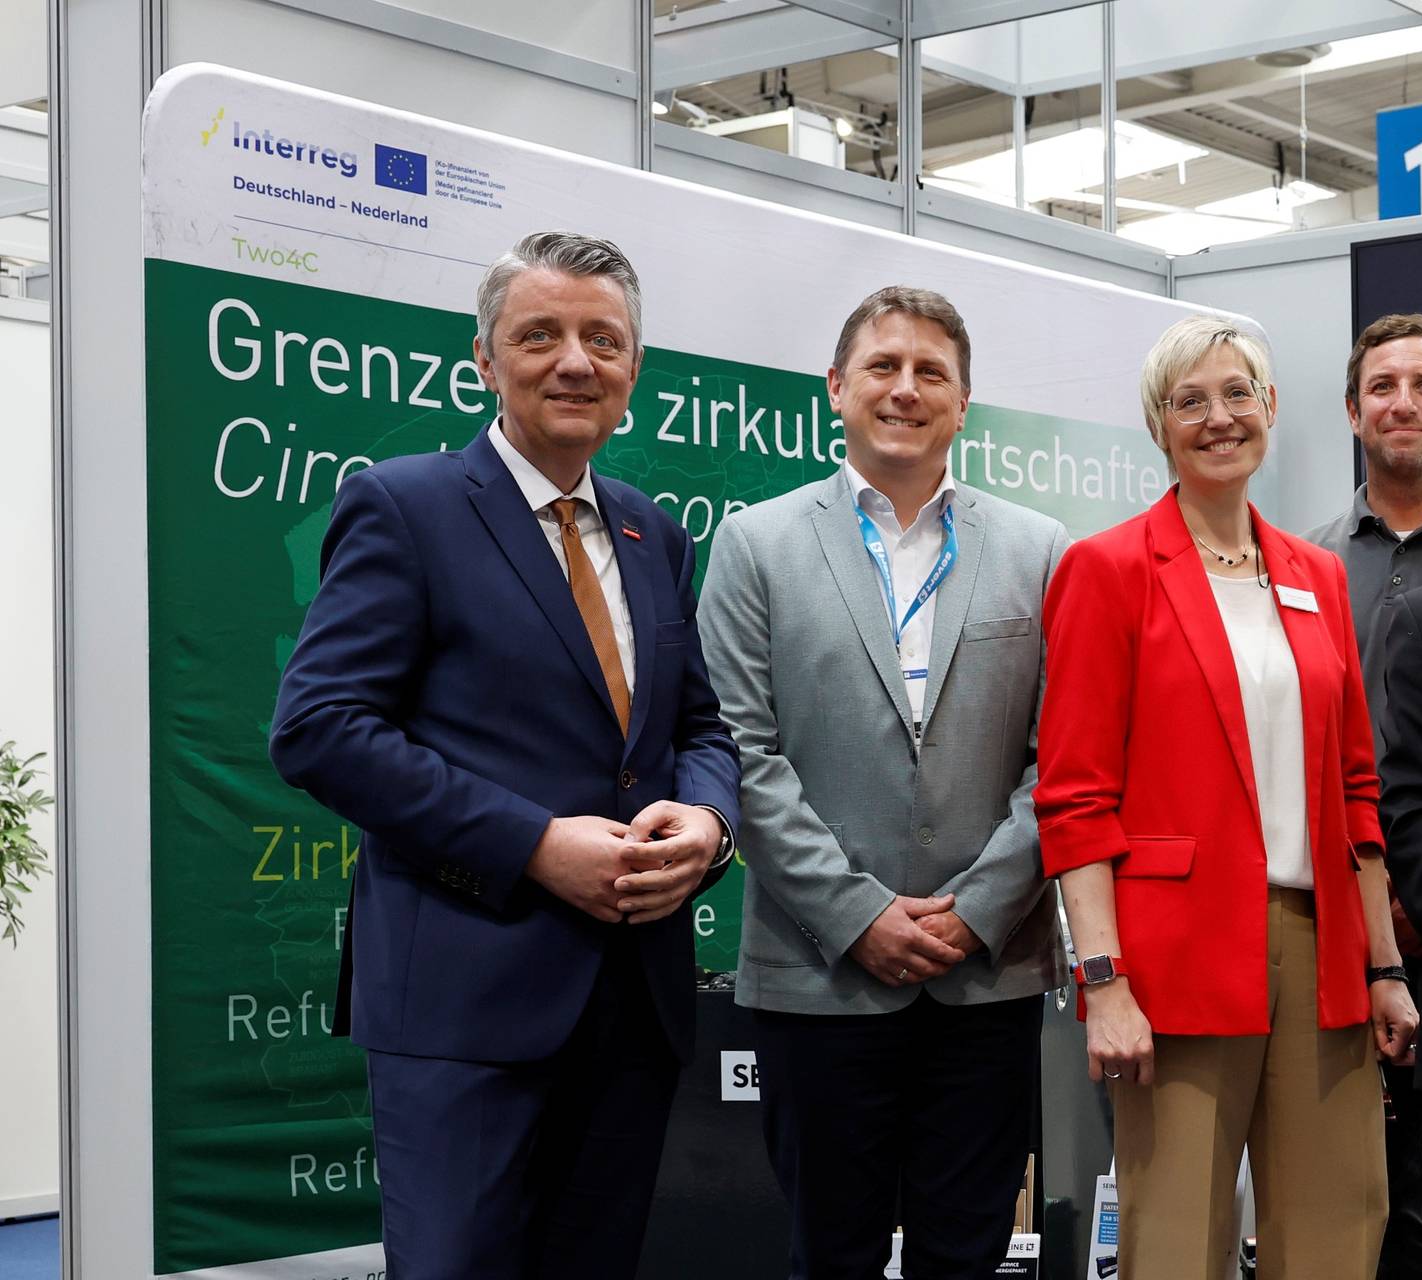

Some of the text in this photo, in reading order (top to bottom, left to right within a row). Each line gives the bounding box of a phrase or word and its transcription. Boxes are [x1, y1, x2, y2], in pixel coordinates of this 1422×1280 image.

[233, 121, 358, 178] Interreg
[233, 175, 336, 209] Deutschland
[351, 201, 428, 228] Nederland
[488, 181, 506, 190] Union
[231, 237, 320, 273] Two4C
[948, 430, 1173, 505] rtschafte
